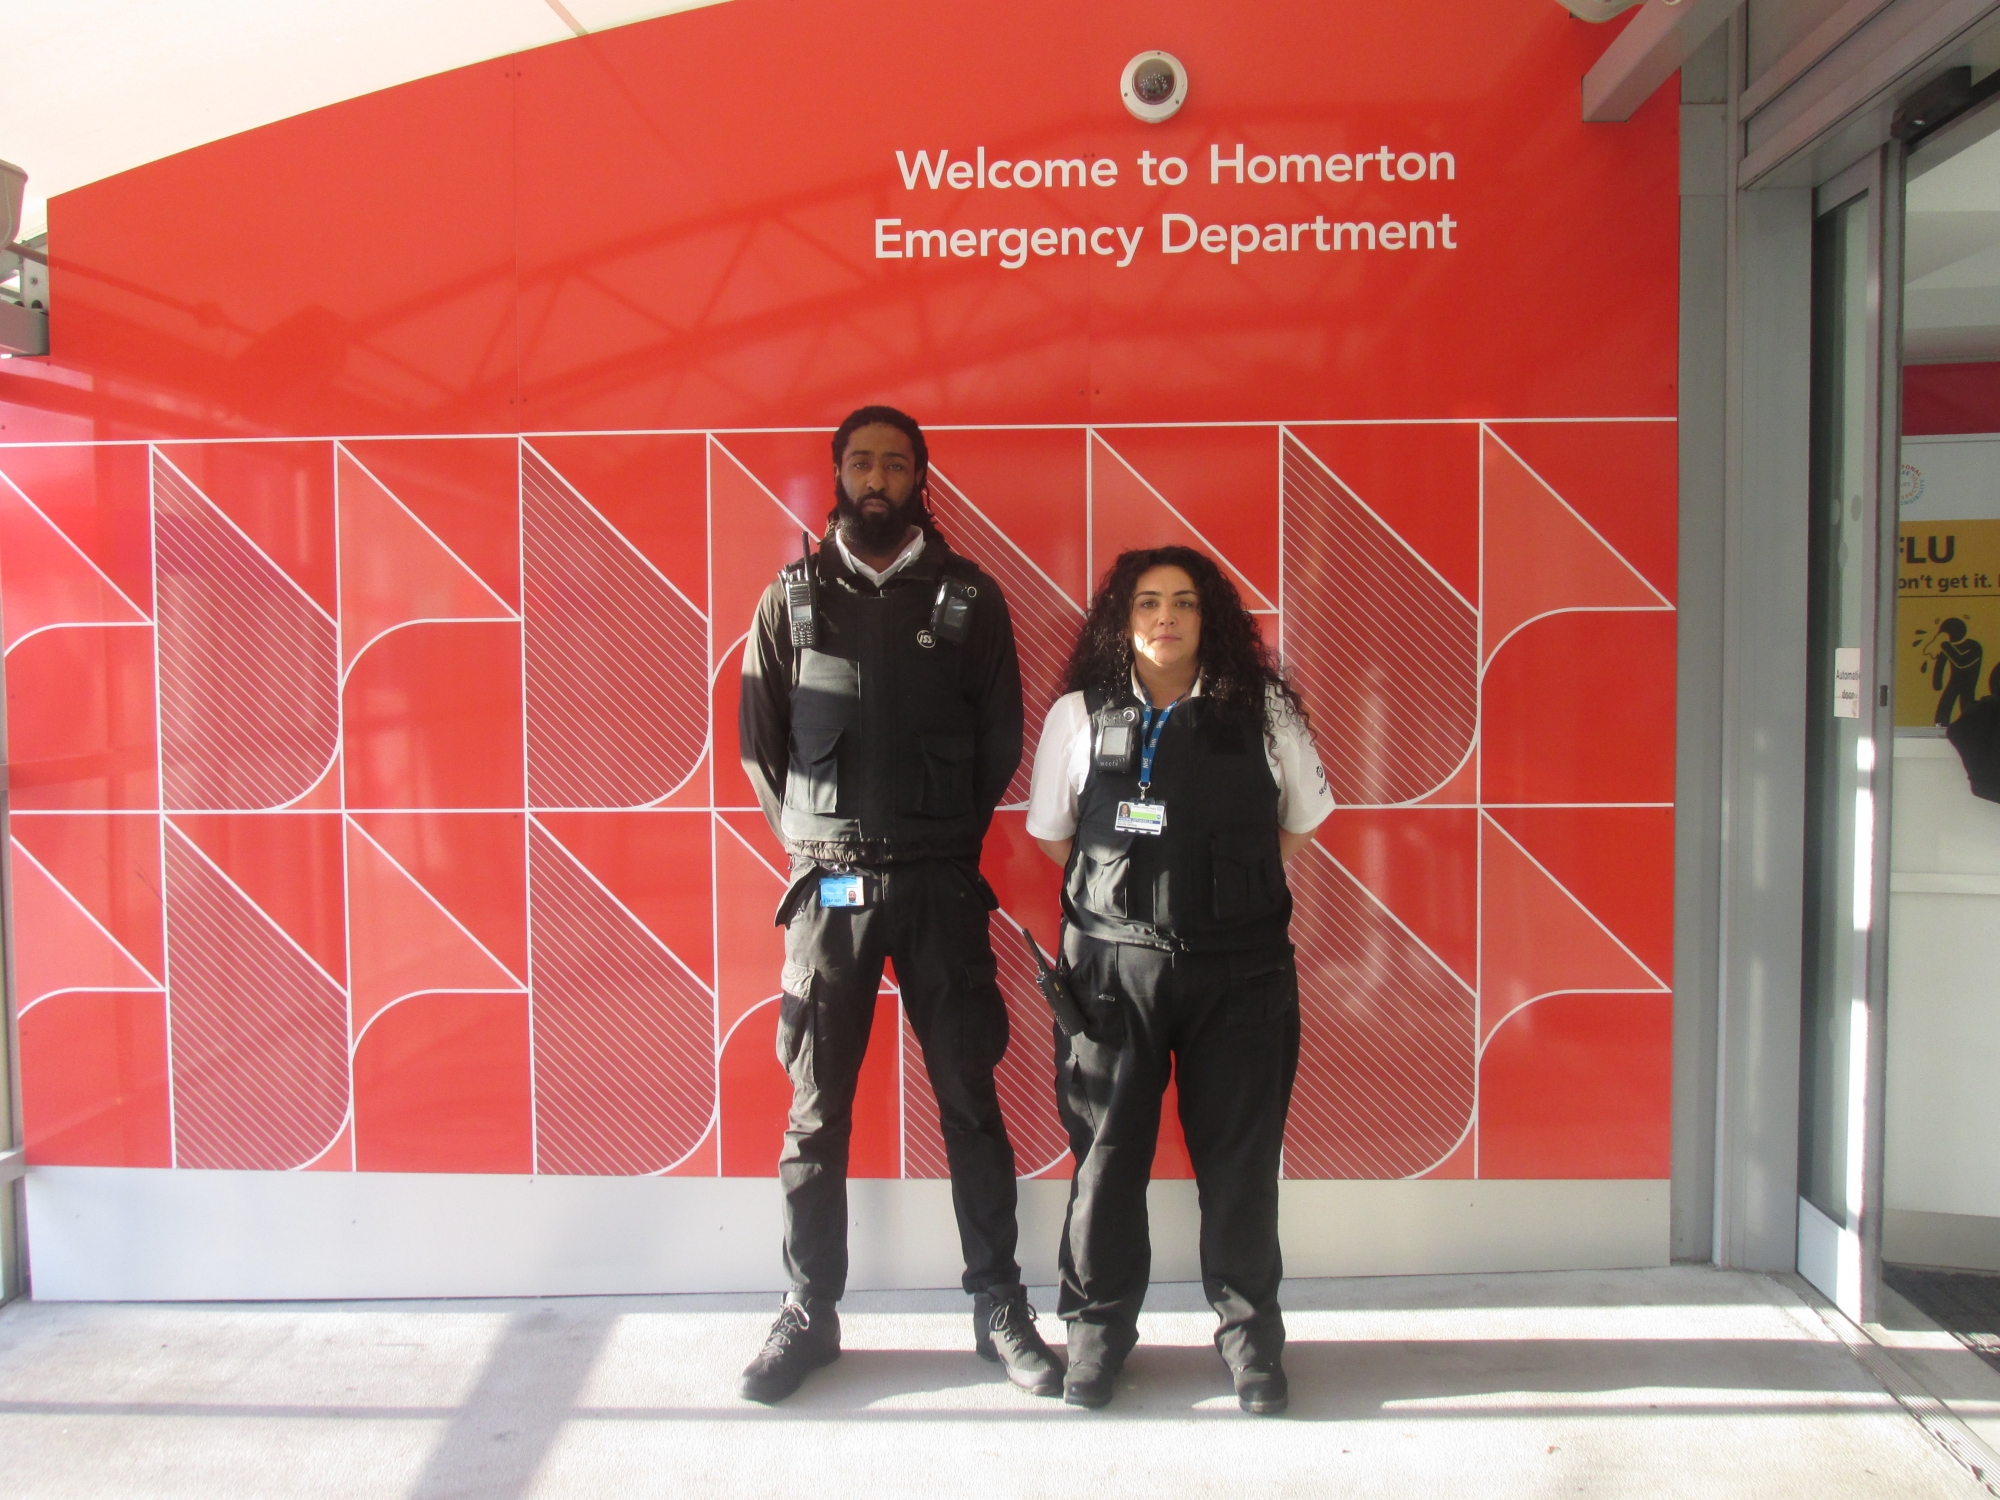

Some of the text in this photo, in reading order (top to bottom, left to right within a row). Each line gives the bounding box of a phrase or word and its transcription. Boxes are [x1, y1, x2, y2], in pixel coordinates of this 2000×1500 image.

[895, 143, 1455, 190] Welcome to Homerton
[875, 213, 1457, 269] Emergency Department
[1938, 575, 1968, 592] get
[1974, 573, 1992, 588] it.
